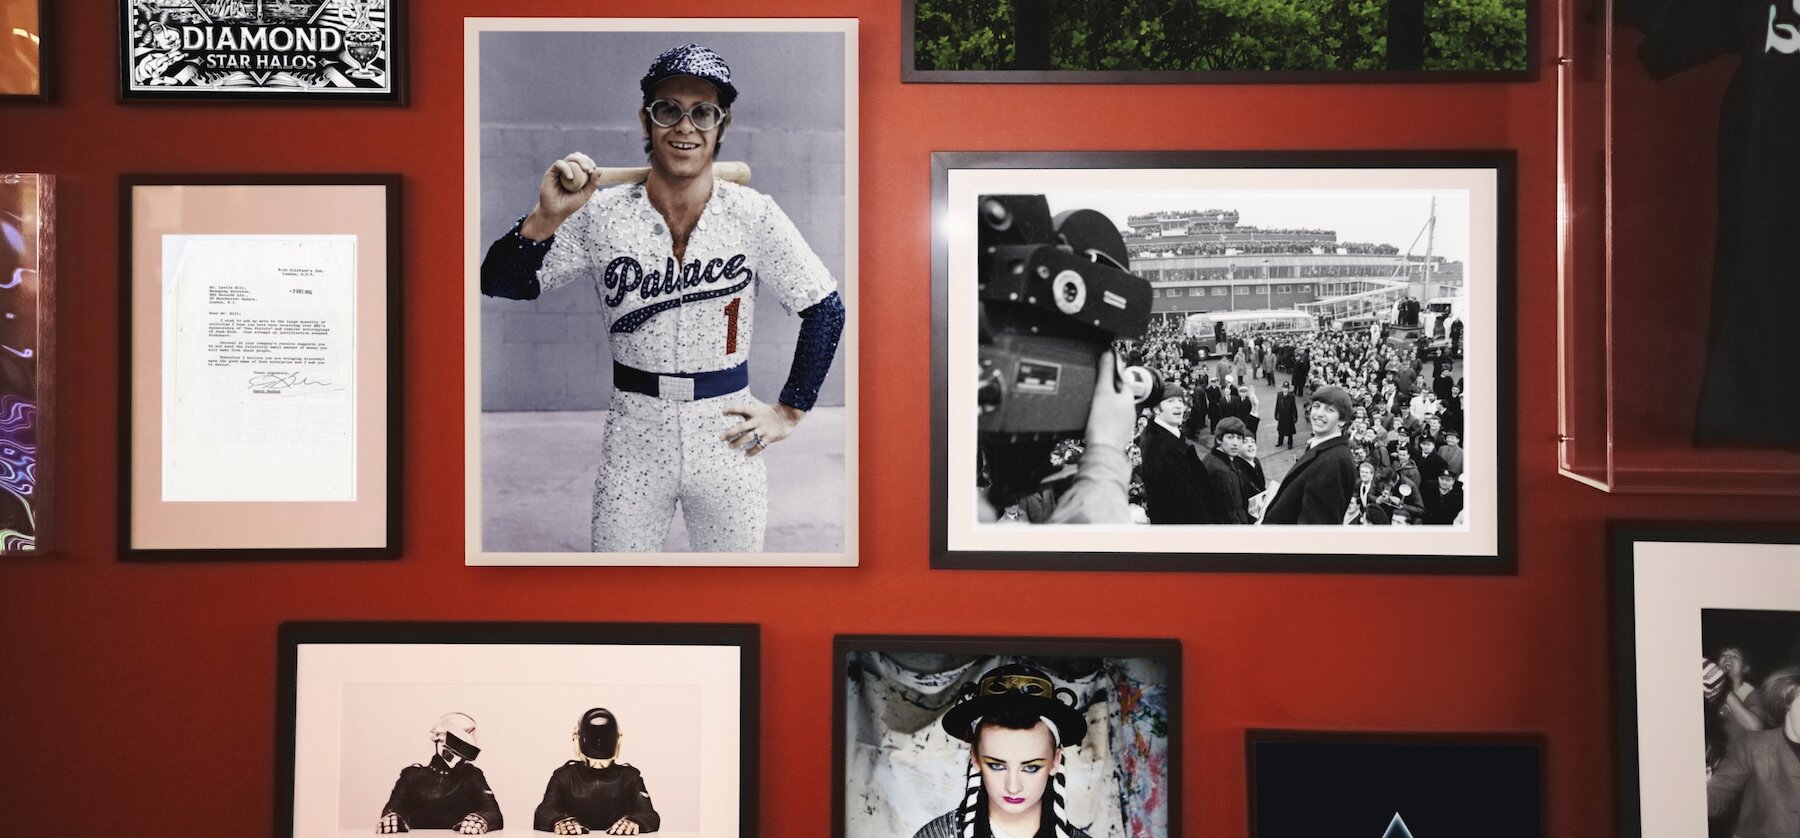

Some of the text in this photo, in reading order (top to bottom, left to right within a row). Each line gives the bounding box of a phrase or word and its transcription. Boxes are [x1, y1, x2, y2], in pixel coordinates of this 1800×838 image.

[182, 26, 342, 52] DIAMOND
[206, 54, 317, 70] STAR HALOS
[604, 254, 752, 307] Palace
[724, 298, 740, 355] 1
